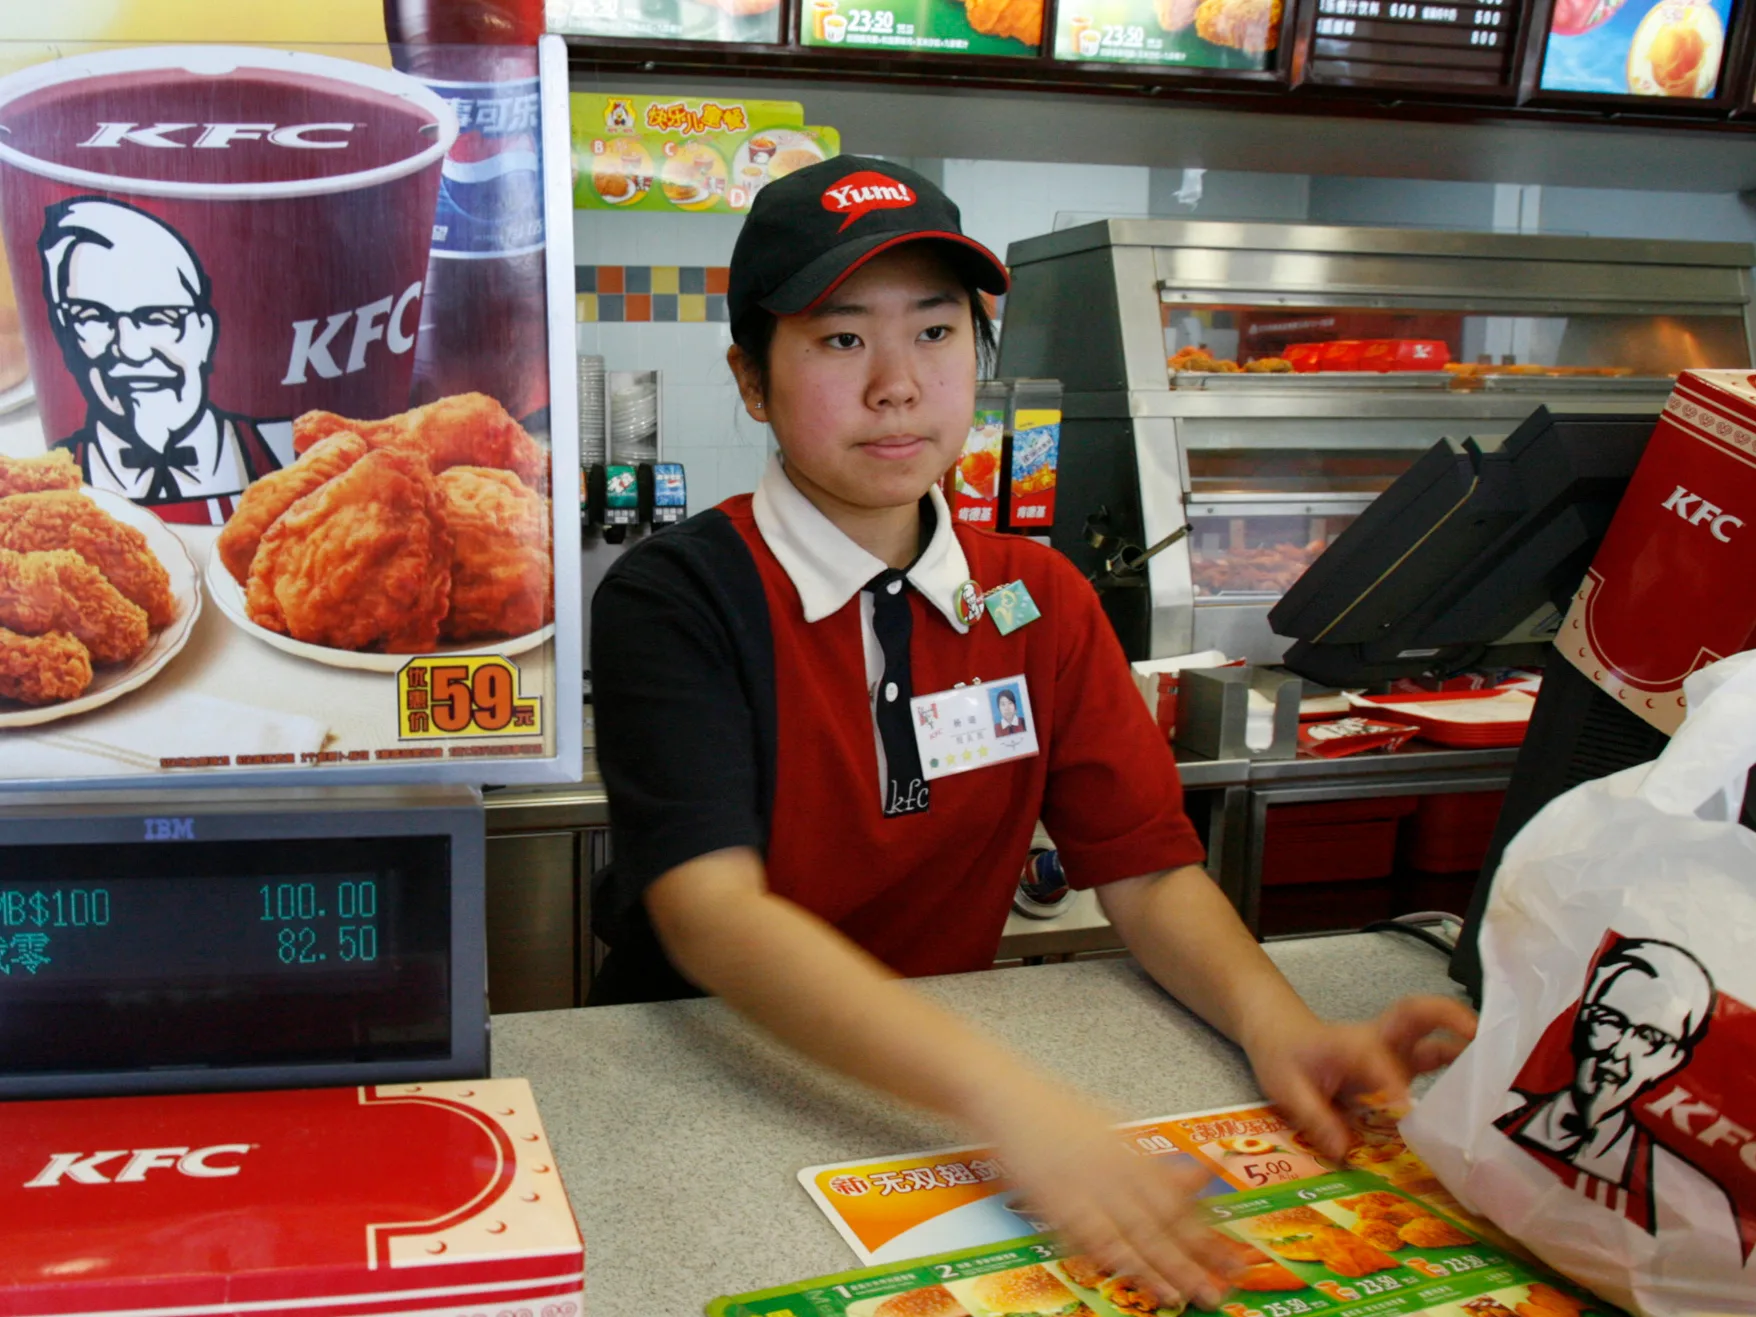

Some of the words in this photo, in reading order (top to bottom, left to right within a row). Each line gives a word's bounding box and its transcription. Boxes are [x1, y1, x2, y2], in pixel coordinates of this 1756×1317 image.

[76, 122, 355, 149] KFC
[825, 183, 911, 208] Yum!
[281, 281, 422, 385] KFC
[1661, 485, 1745, 543] KFC
[144, 817, 195, 840] IBM
[260, 882, 376, 920] 100.00
[278, 924, 377, 963] 82.50
[23, 1143, 250, 1188] KFC
[934, 1265, 959, 1279] 2
[832, 1285, 853, 1299] 1
